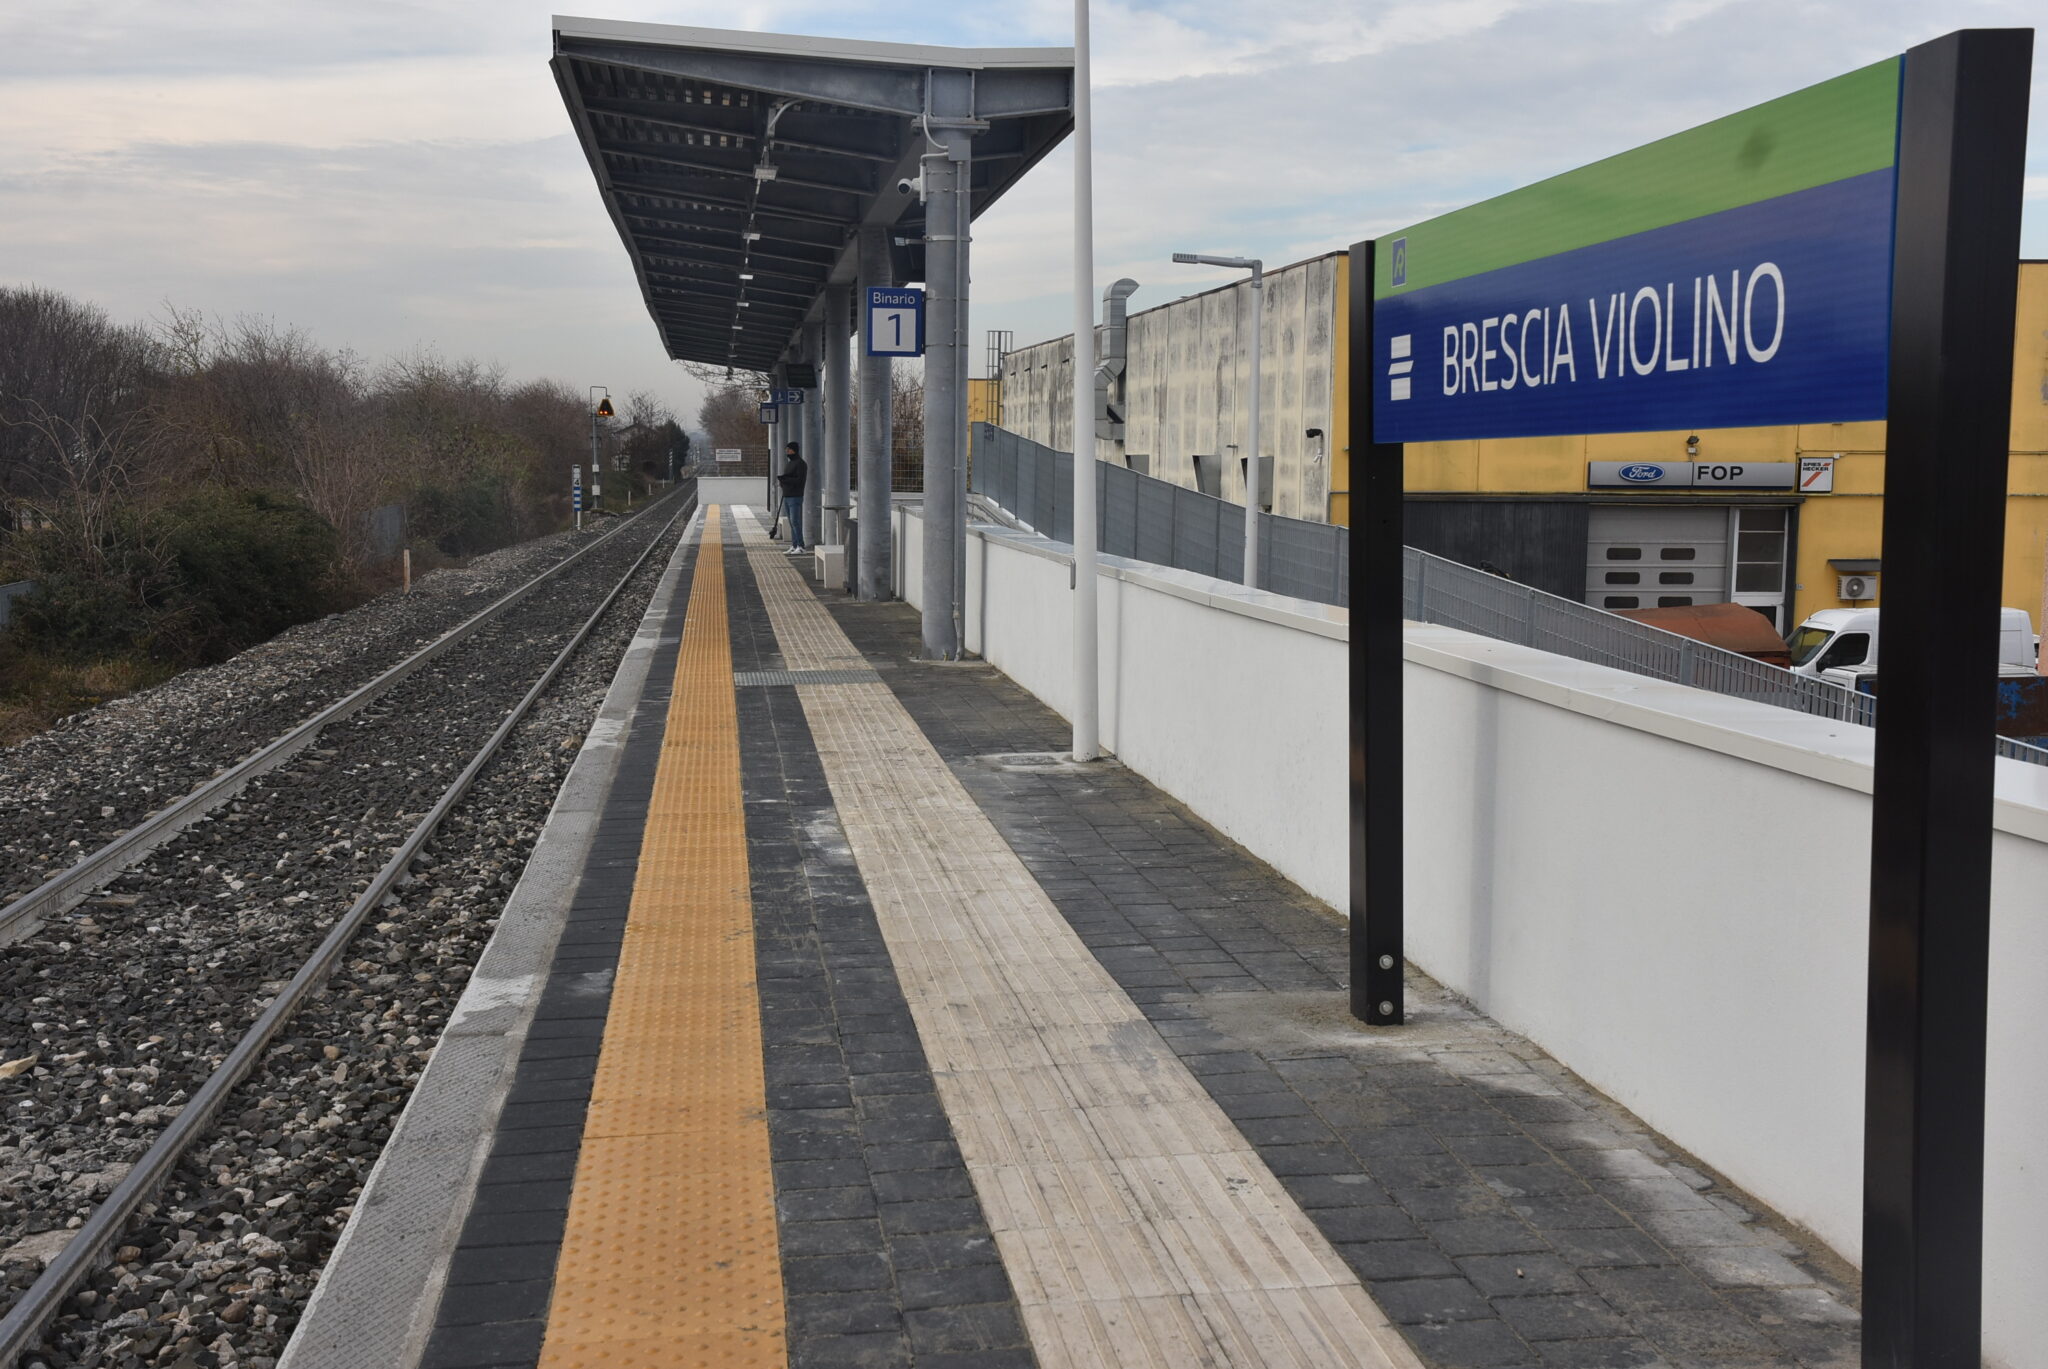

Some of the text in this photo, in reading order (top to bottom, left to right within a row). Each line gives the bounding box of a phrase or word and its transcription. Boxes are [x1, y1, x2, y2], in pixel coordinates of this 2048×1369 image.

[873, 292, 915, 304] Binario
[888, 314, 900, 346] 1
[1443, 262, 1785, 396] BRESCIA VIOLINO
[1629, 466, 1656, 478] Ford
[1698, 466, 1743, 480] FOP
